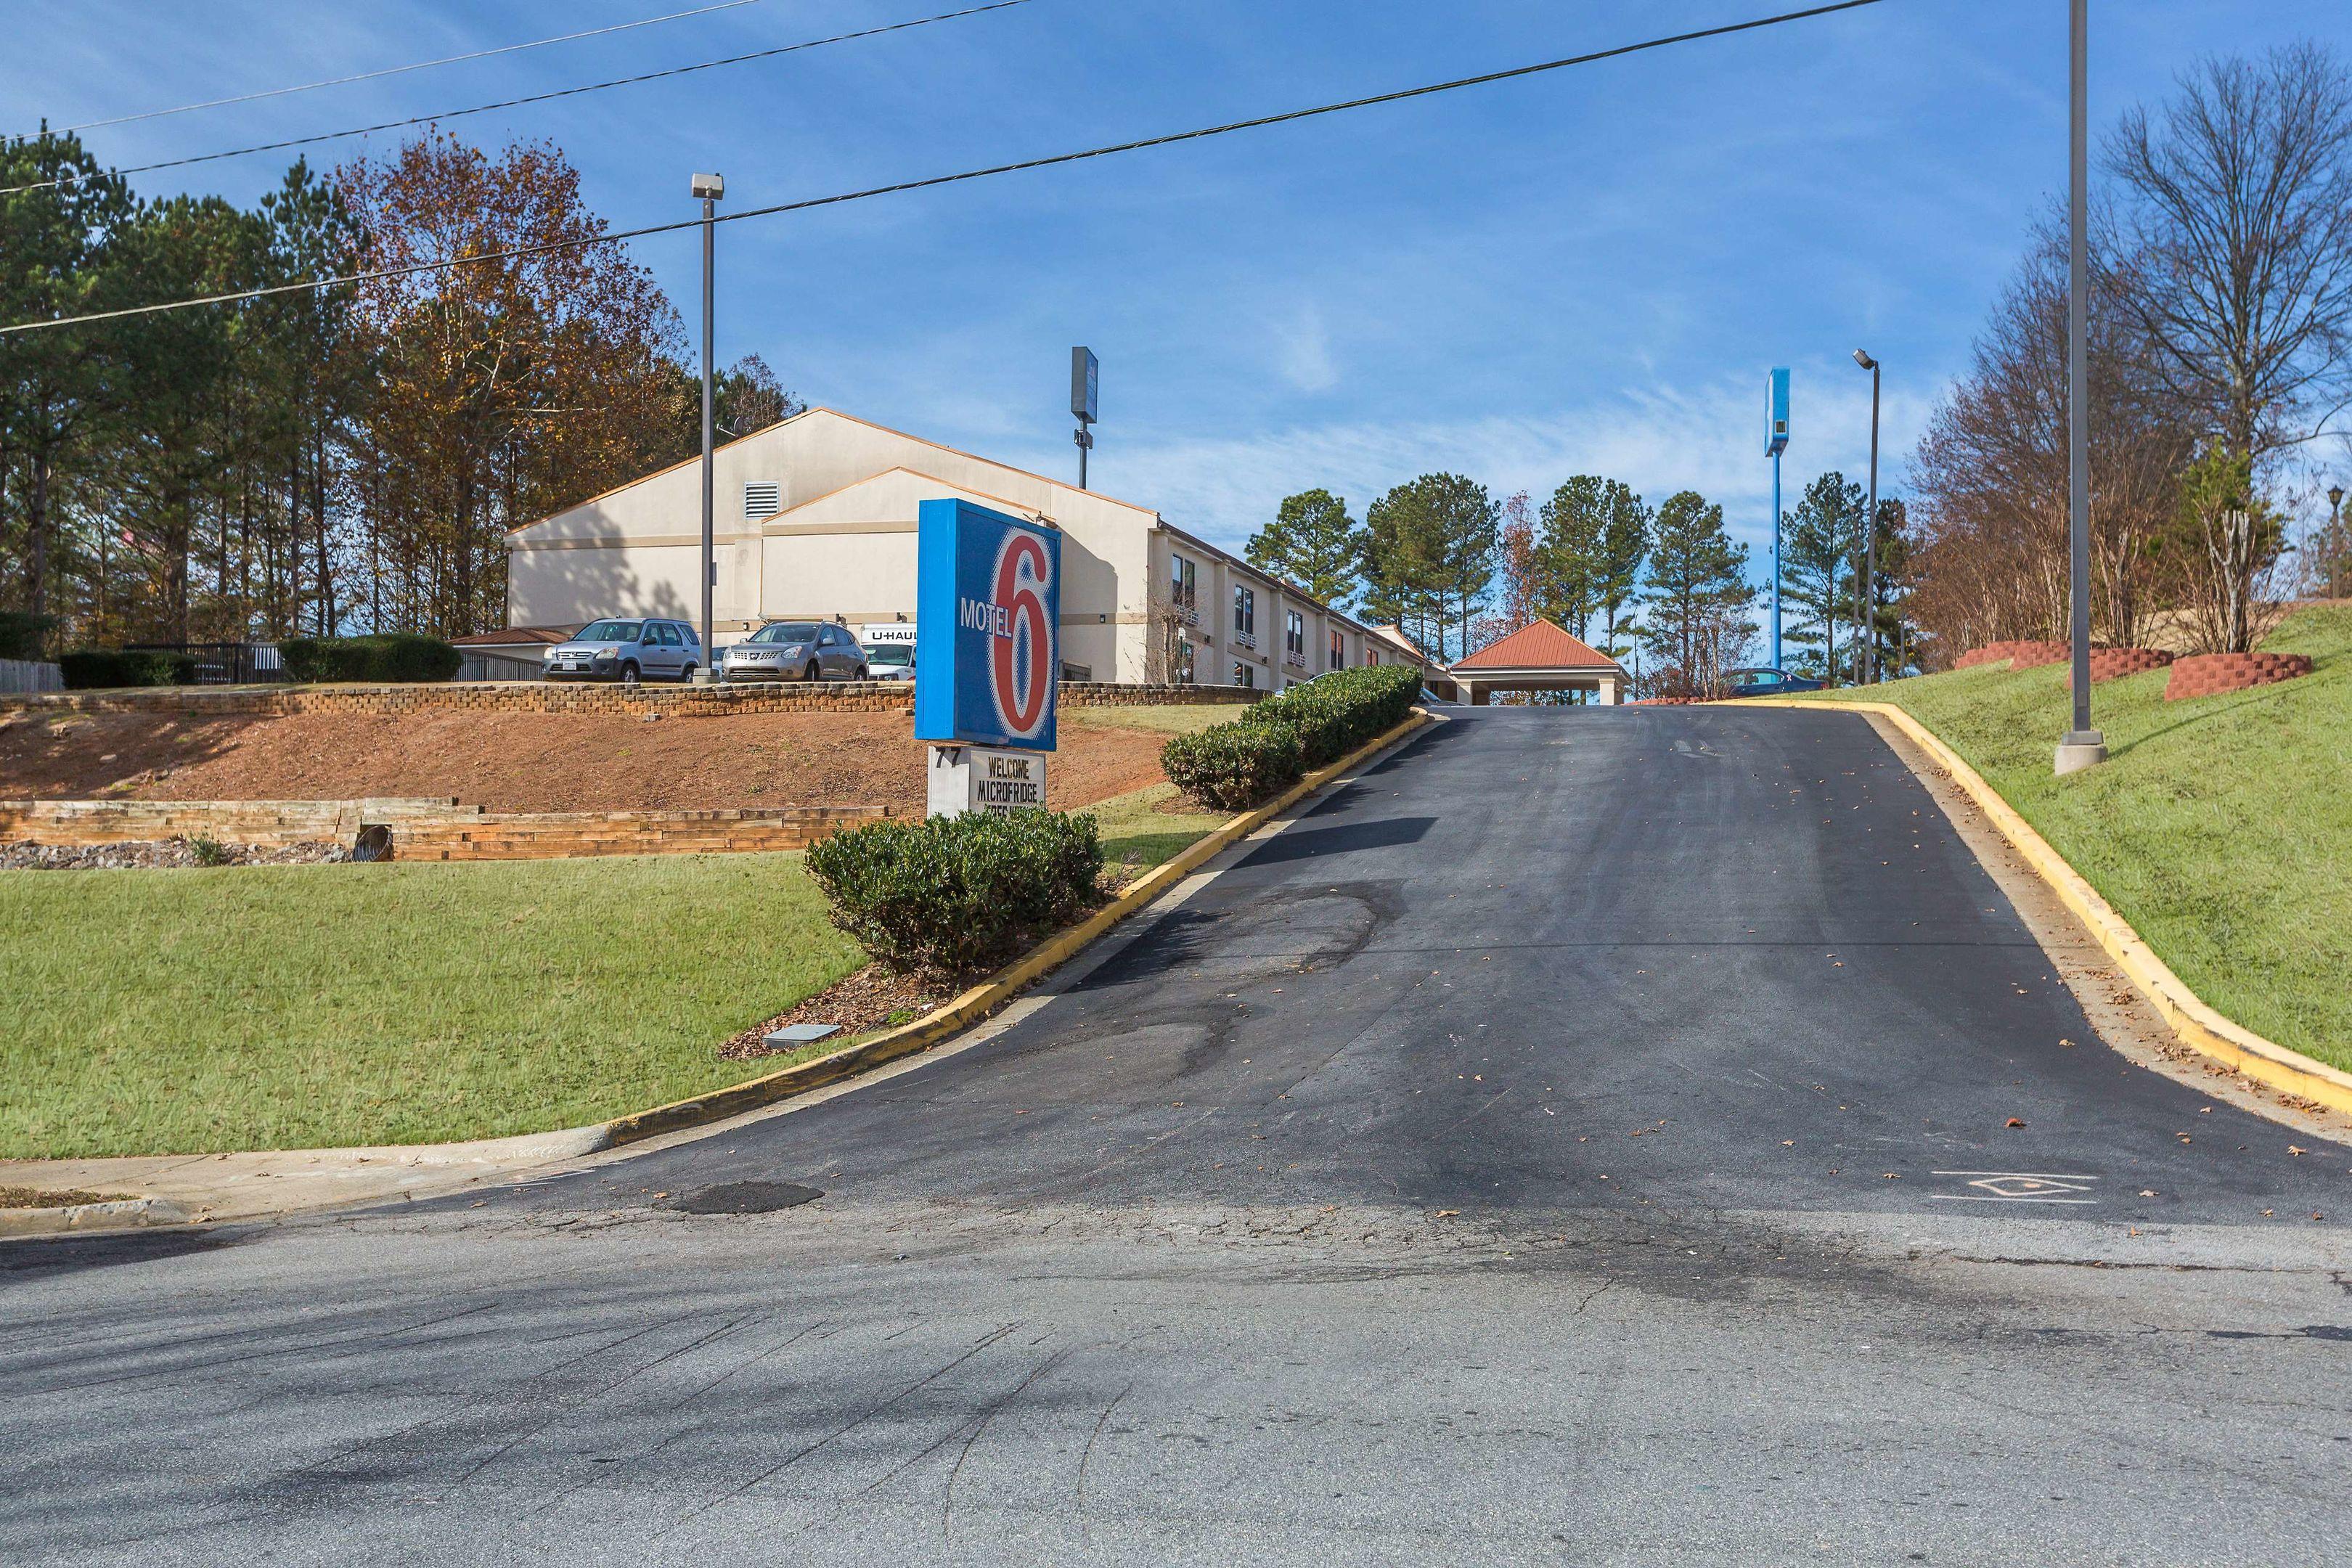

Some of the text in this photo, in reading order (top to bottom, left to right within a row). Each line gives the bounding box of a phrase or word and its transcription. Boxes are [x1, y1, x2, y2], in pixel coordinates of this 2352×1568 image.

[960, 534, 1048, 733] MOTEL 6
[935, 746, 961, 769] 77
[988, 756, 1029, 780] WELCOME
[977, 780, 1037, 804] MICROFRIDGE
